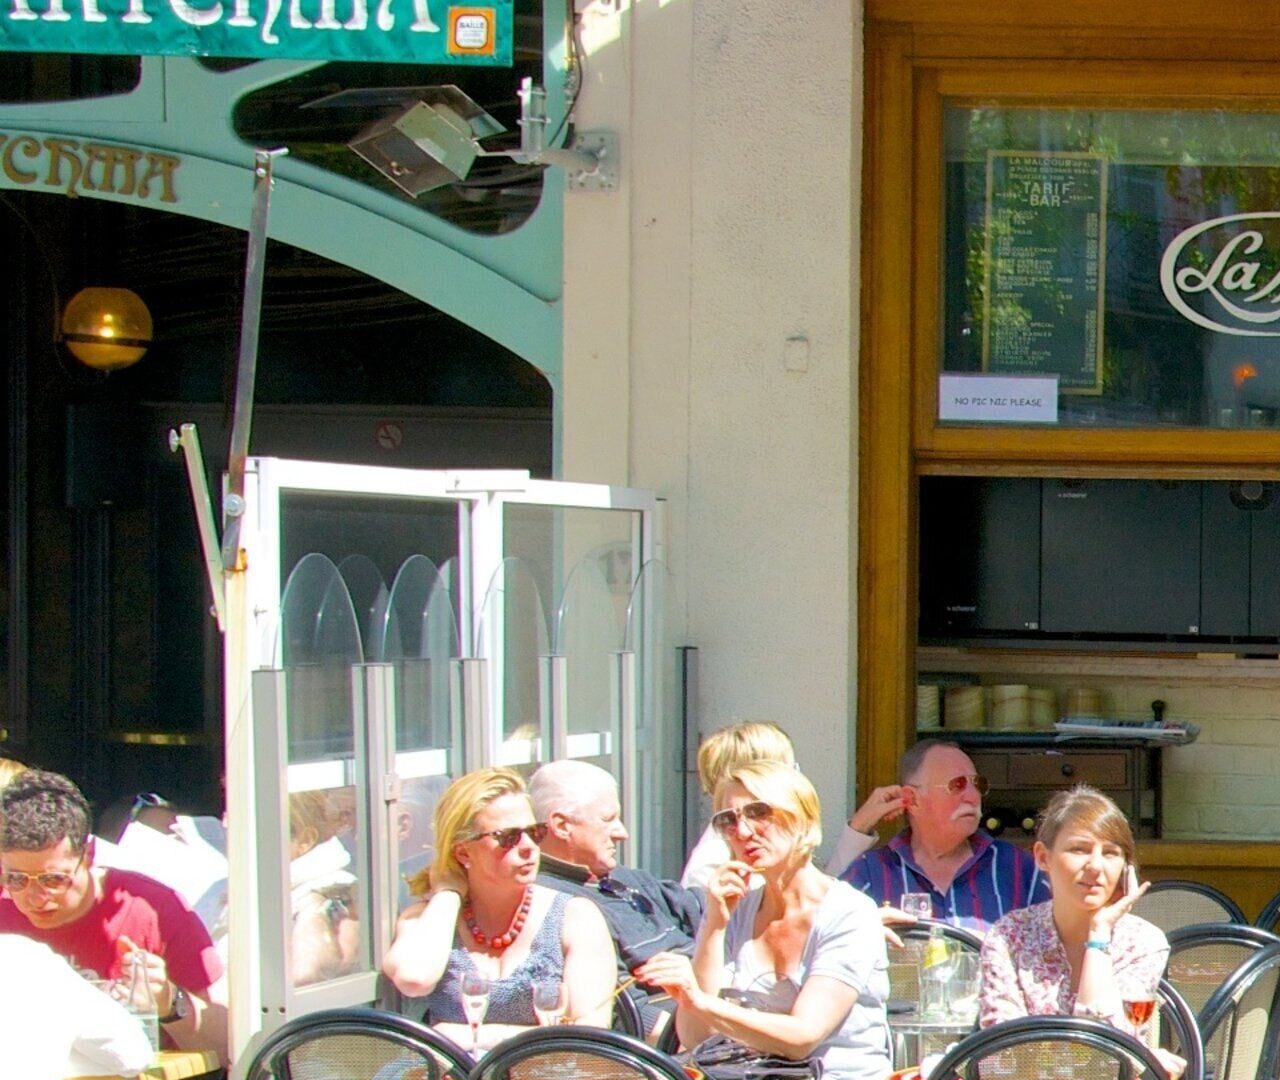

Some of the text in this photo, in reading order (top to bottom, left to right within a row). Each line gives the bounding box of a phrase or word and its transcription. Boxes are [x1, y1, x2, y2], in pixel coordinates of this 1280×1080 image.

[1023, 181, 1070, 195] TARIF
[954, 397, 1042, 408] NO PIC NIC PLEASE
